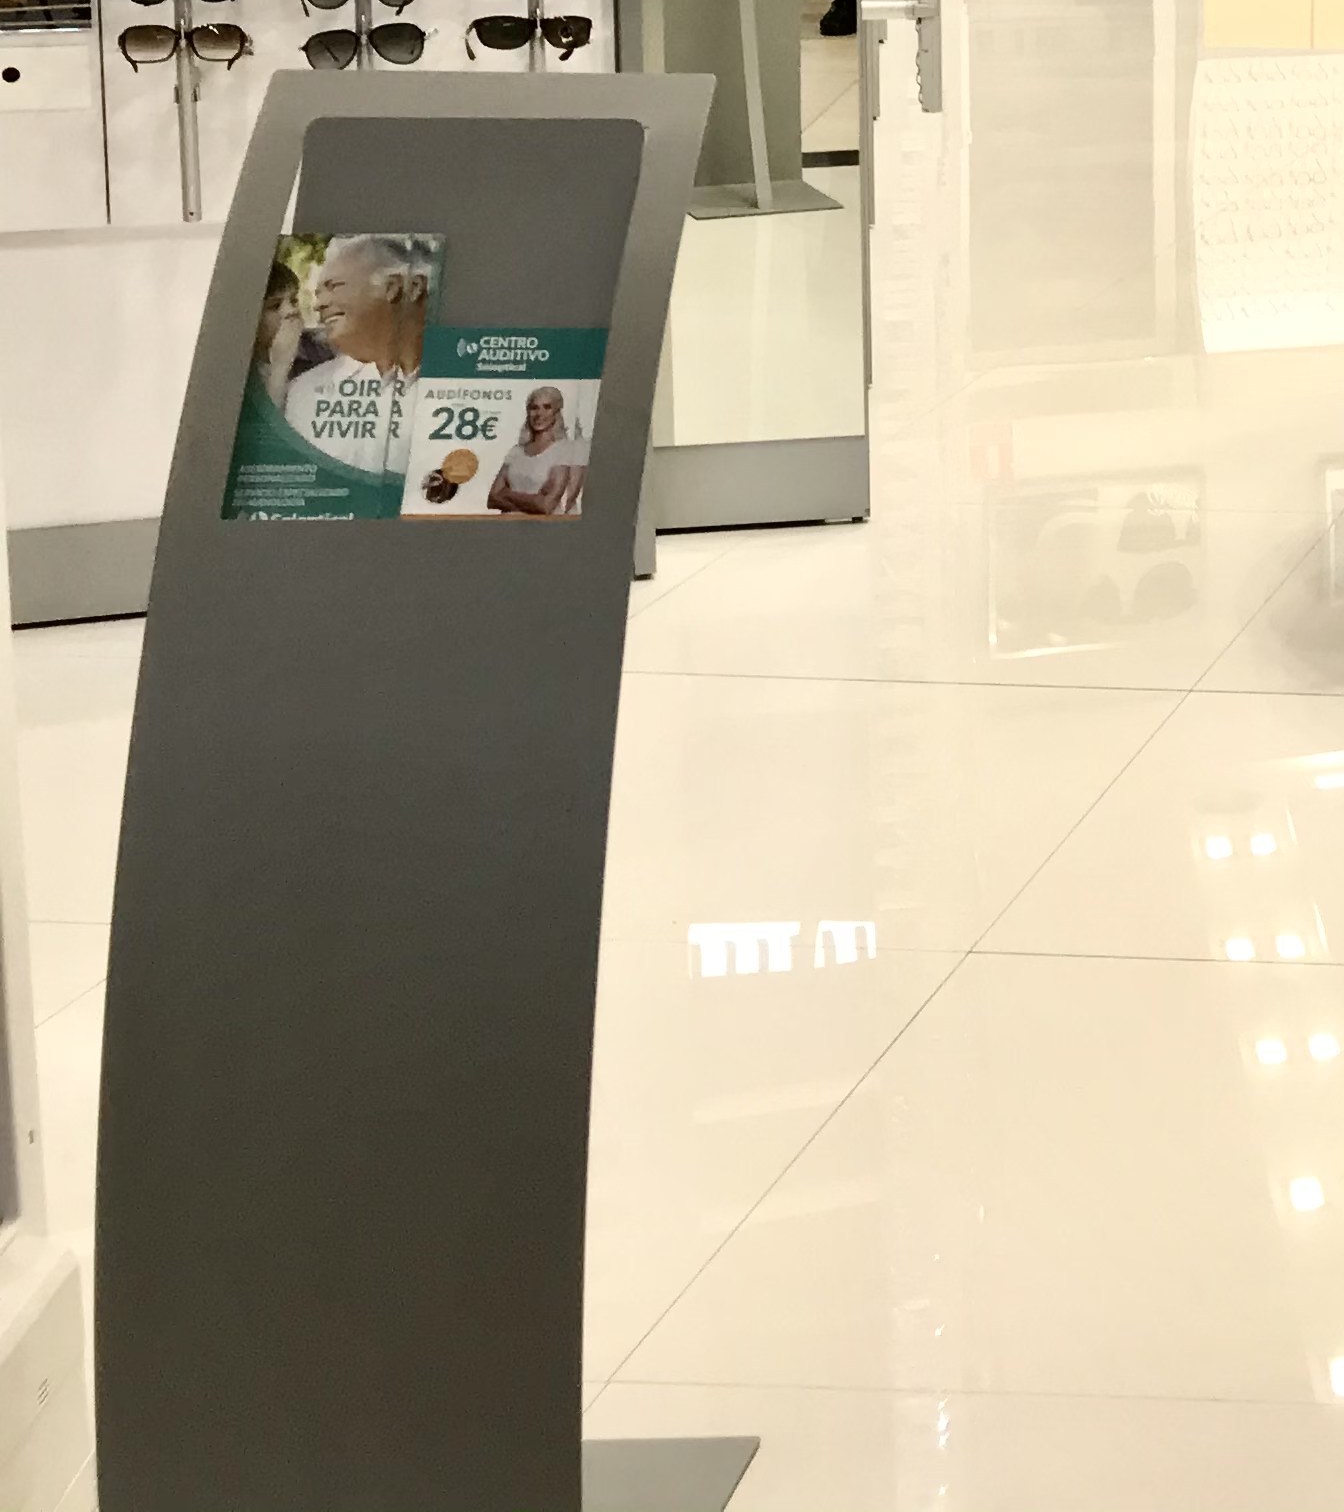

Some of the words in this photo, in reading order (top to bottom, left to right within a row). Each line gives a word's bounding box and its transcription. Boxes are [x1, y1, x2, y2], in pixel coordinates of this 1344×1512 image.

[479, 336, 539, 349] CENTRO
[477, 349, 550, 362] AUDITIVO
[338, 379, 382, 398] OIR
[424, 388, 512, 401] AUDÍFONOS
[315, 399, 380, 418] PARA
[311, 420, 377, 439] VIVIR
[428, 406, 498, 441] 28€
